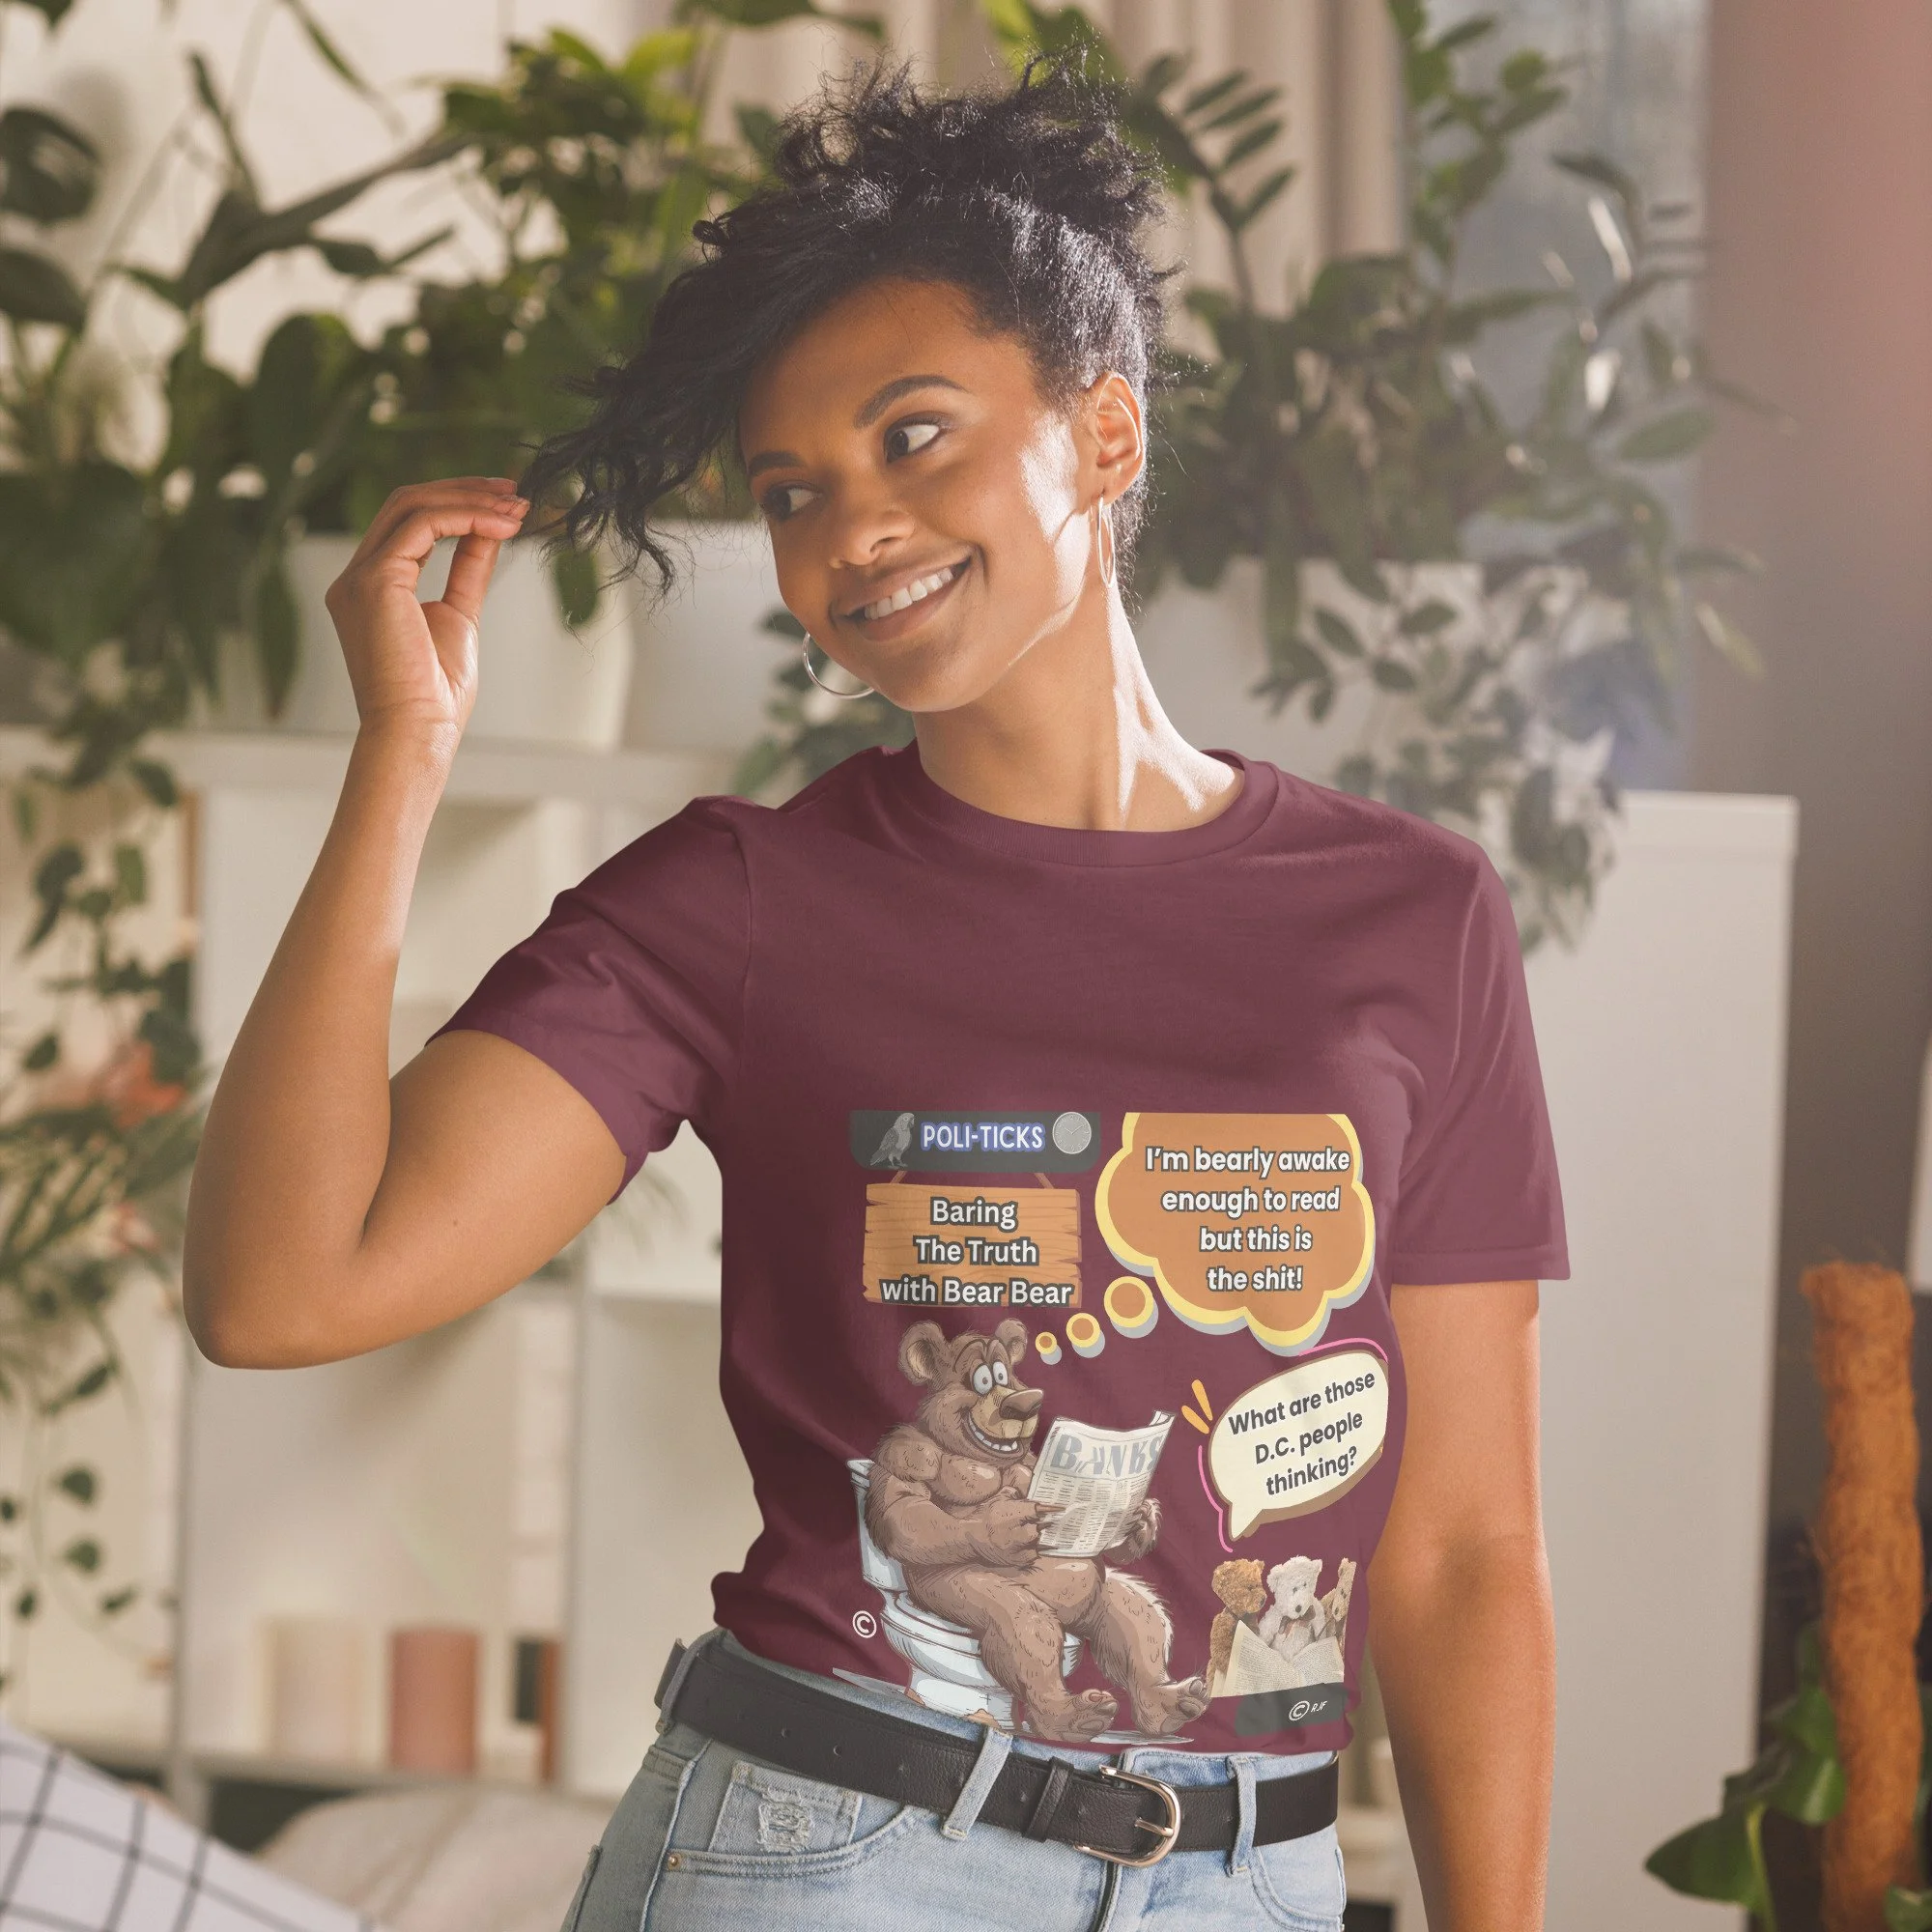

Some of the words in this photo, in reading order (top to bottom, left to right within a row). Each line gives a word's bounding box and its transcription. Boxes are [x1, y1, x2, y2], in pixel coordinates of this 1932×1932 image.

[923, 1124, 1044, 1150] POLI-TICKS
[1194, 1146, 1275, 1179] bearly
[1277, 1147, 1351, 1171] awake
[931, 1198, 1017, 1231] Baring
[1160, 1185, 1259, 1219] enough
[1263, 1187, 1288, 1211] to
[1291, 1185, 1341, 1211] read
[914, 1237, 962, 1263] The
[966, 1238, 1038, 1264] Truth
[1199, 1226, 1243, 1252] but
[1246, 1225, 1291, 1251] this
[1293, 1224, 1314, 1251] is
[880, 1276, 937, 1303] with
[943, 1279, 1005, 1304] Bear
[1010, 1280, 1073, 1305] Bear
[1207, 1265, 1249, 1292] the
[1251, 1264, 1304, 1292] shit!
[1228, 1402, 1286, 1435] What
[1289, 1393, 1322, 1417] are
[1324, 1372, 1376, 1405] those
[1255, 1436, 1295, 1464] D.C.
[1298, 1411, 1364, 1457] people
[1265, 1445, 1358, 1496] thinking?
